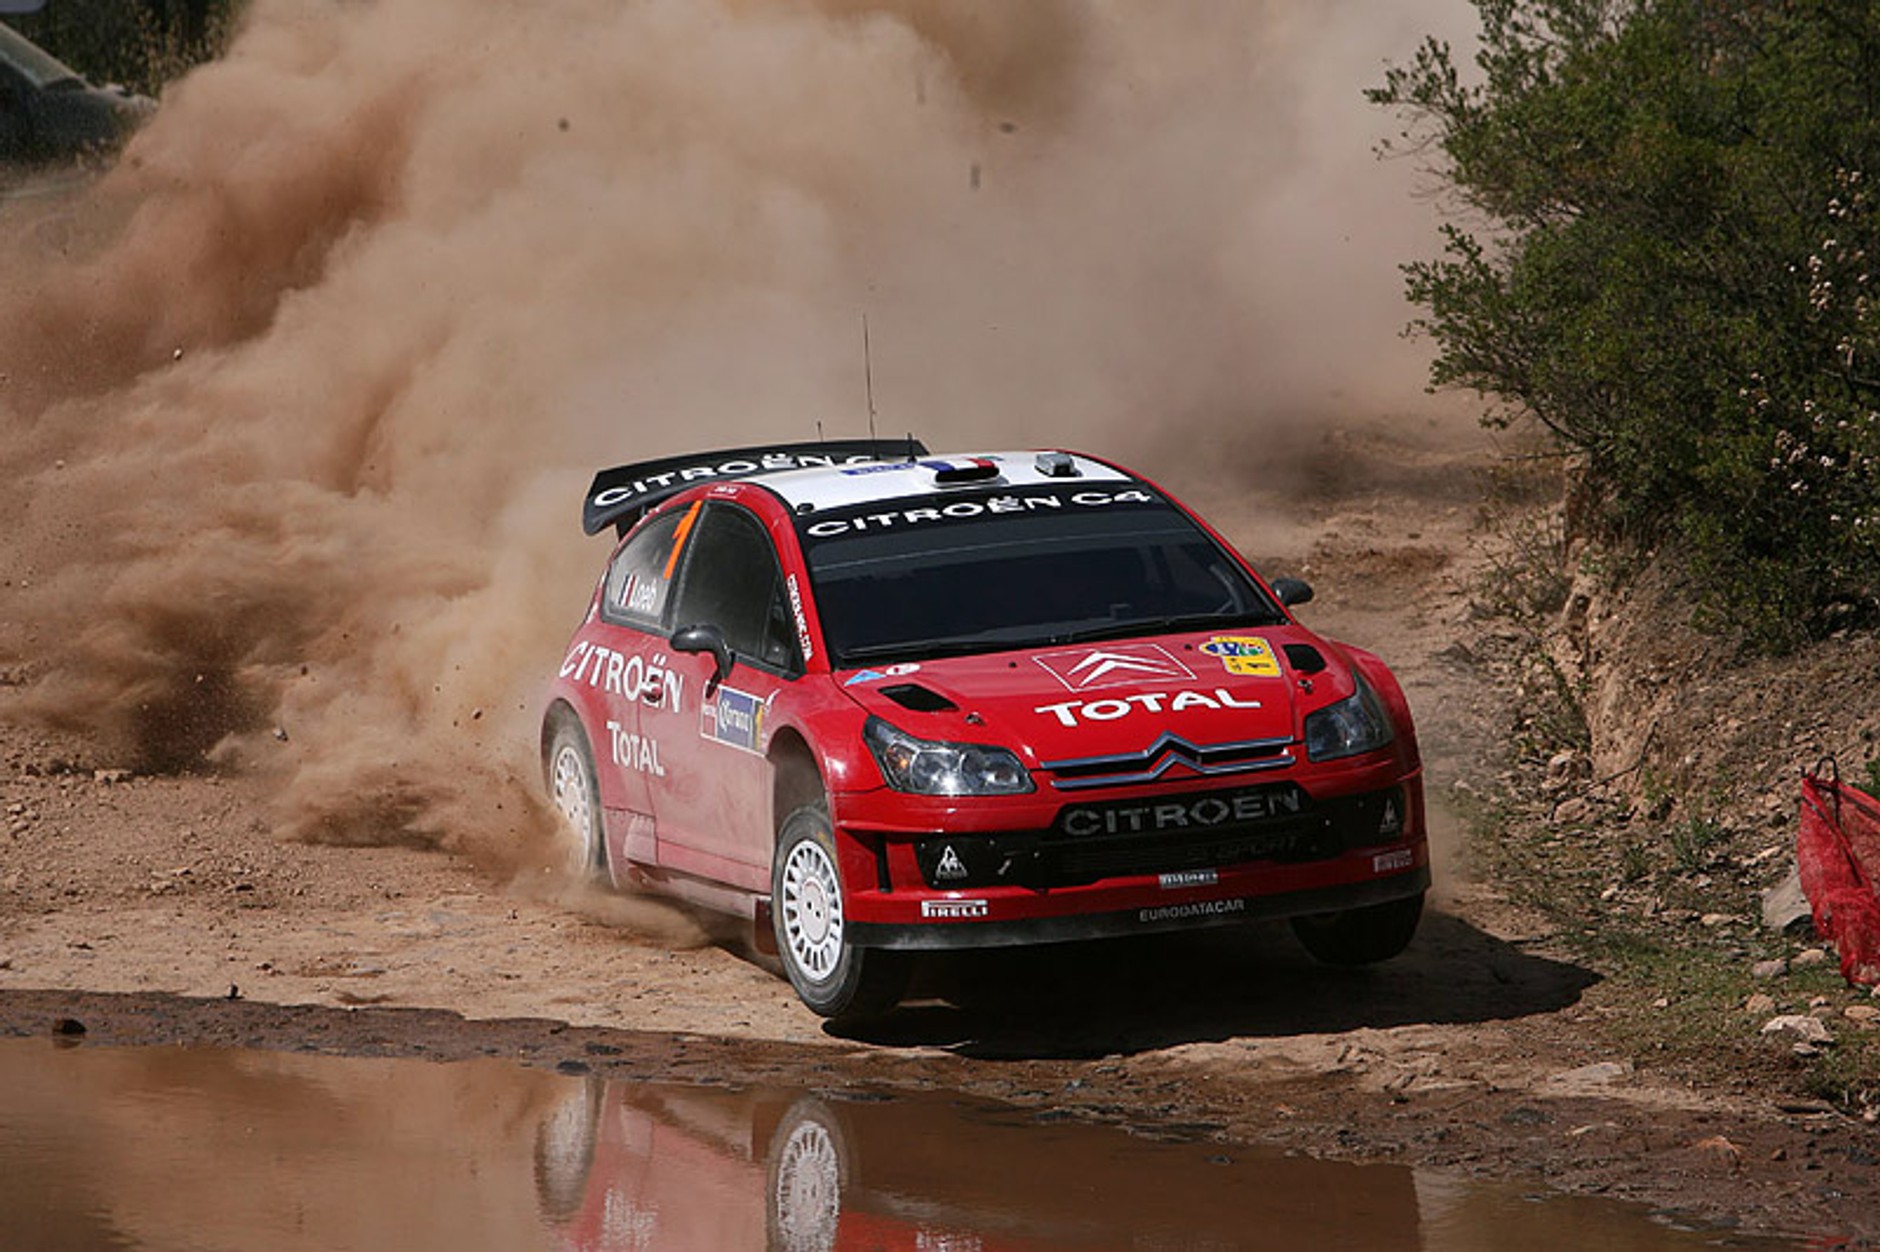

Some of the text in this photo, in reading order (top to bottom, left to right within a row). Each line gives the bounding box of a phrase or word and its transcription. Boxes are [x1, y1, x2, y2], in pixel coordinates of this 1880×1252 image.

[807, 490, 1151, 536] CITROËN C4
[559, 641, 684, 713] CITROËN
[1034, 689, 1262, 727] TOTAL
[606, 720, 665, 777] TOTAL
[921, 899, 988, 917] PIRELLI
[1140, 899, 1245, 921] EURODATACAR
